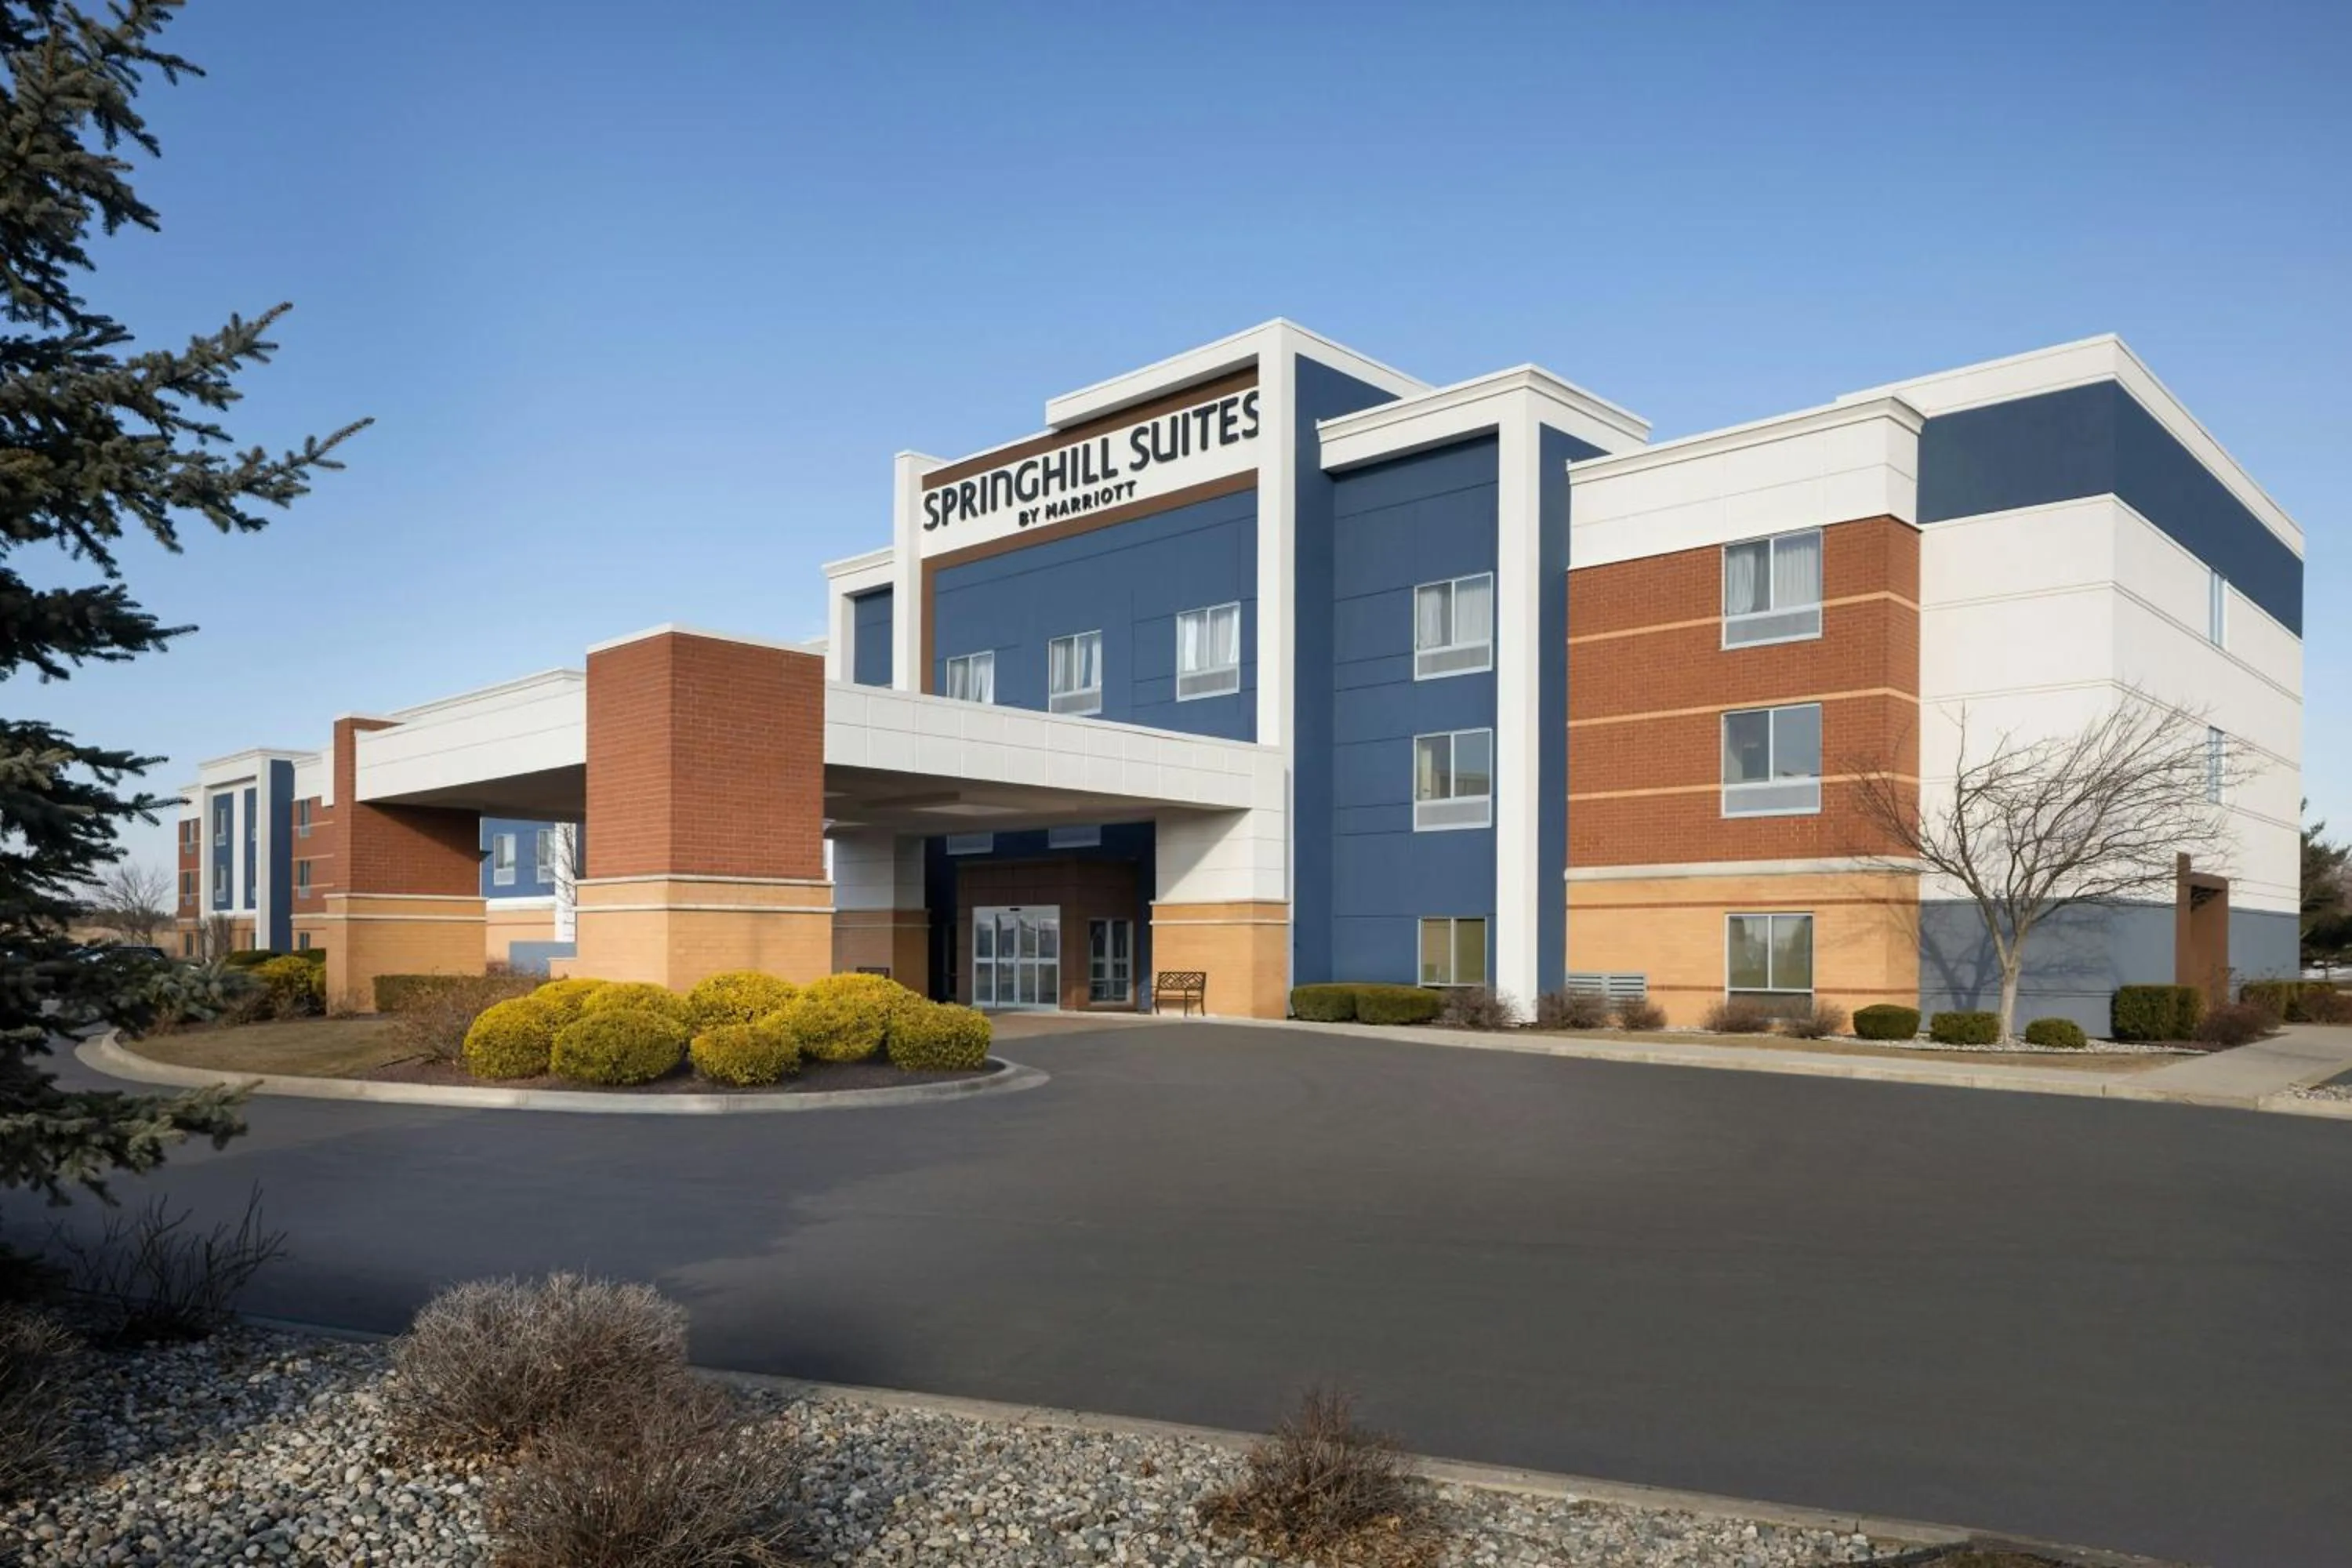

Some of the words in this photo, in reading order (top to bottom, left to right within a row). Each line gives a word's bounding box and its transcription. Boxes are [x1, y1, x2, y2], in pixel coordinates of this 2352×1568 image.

[923, 437, 1119, 531] SPRINGHILL
[1129, 390, 1259, 471] SUITES
[1018, 508, 1040, 527] BY
[1045, 480, 1137, 520] MARRIOTT
